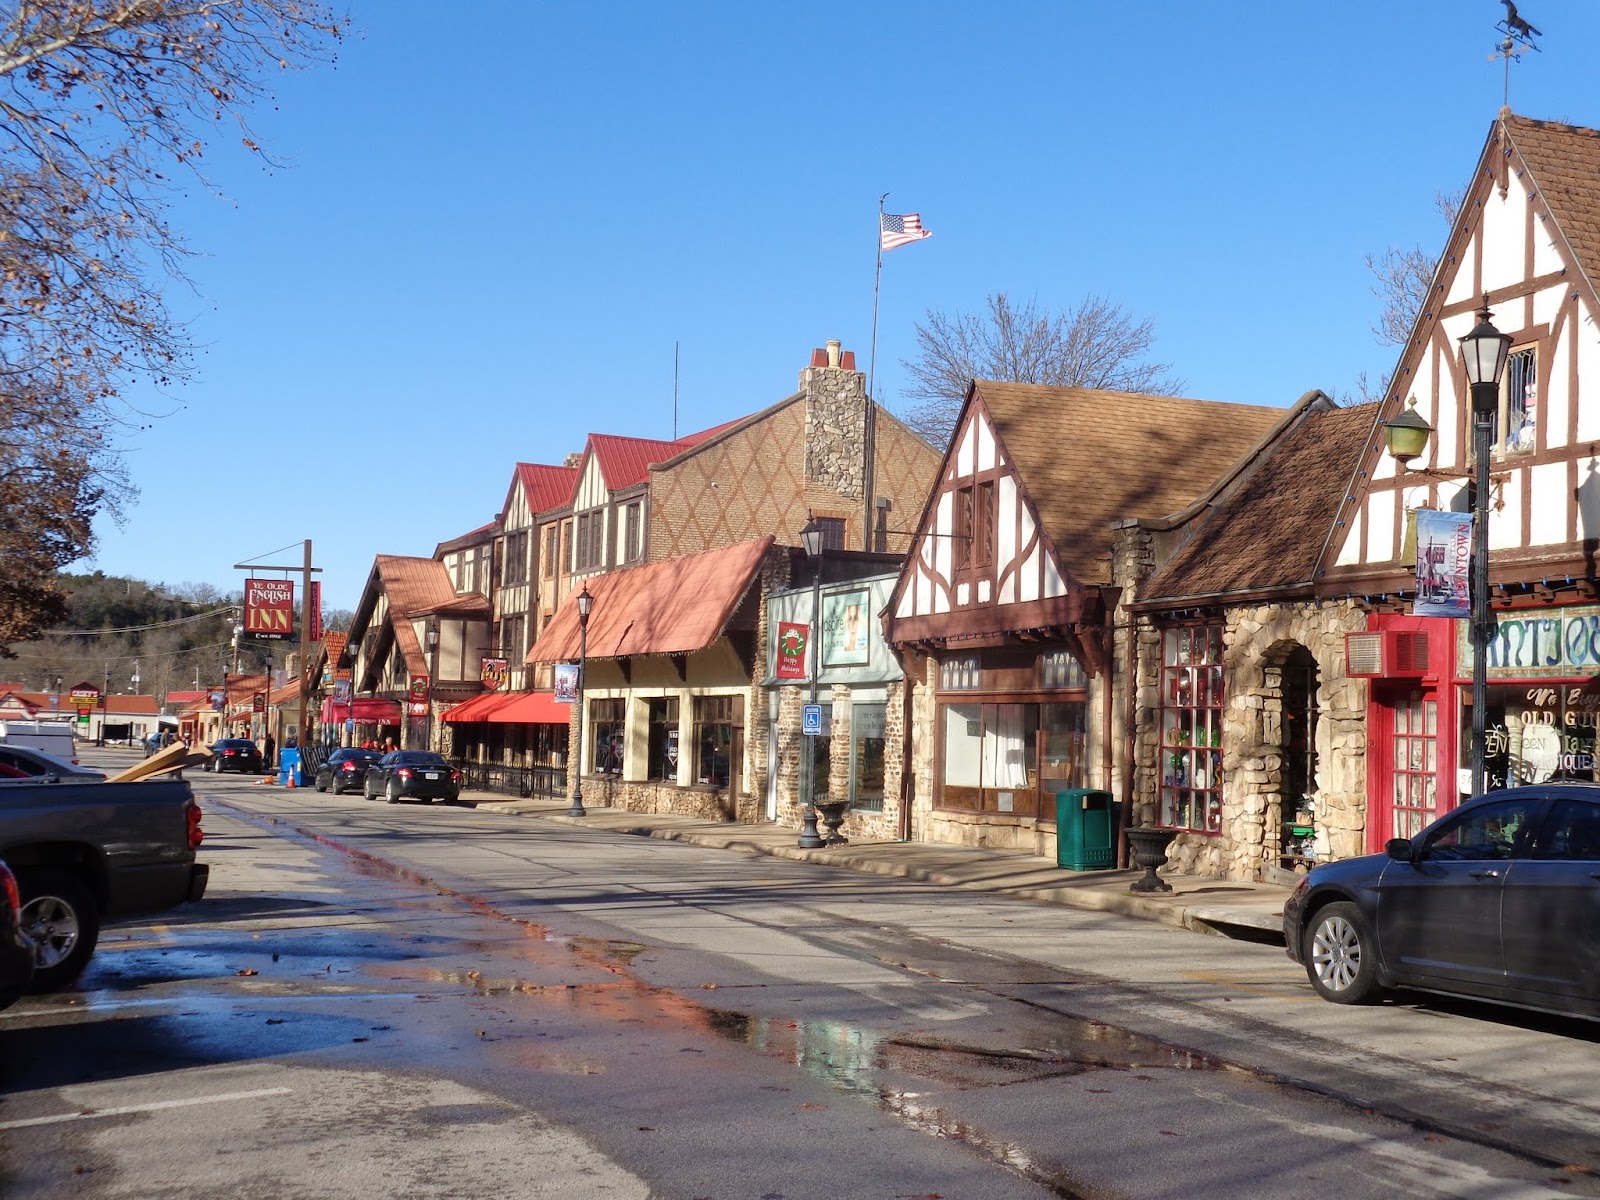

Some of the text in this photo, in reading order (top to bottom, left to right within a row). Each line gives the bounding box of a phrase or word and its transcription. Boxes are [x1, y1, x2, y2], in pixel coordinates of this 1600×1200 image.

[1449, 521, 1458, 572] HISTORIC
[1455, 523, 1470, 609] DOWNTOWN
[248, 589, 291, 607] ENGLISH
[248, 608, 290, 629] INN
[780, 665, 800, 674] Holidays
[783, 656, 798, 666] Happy
[1526, 688, 1557, 707] We
[1521, 710, 1554, 727] OLD
